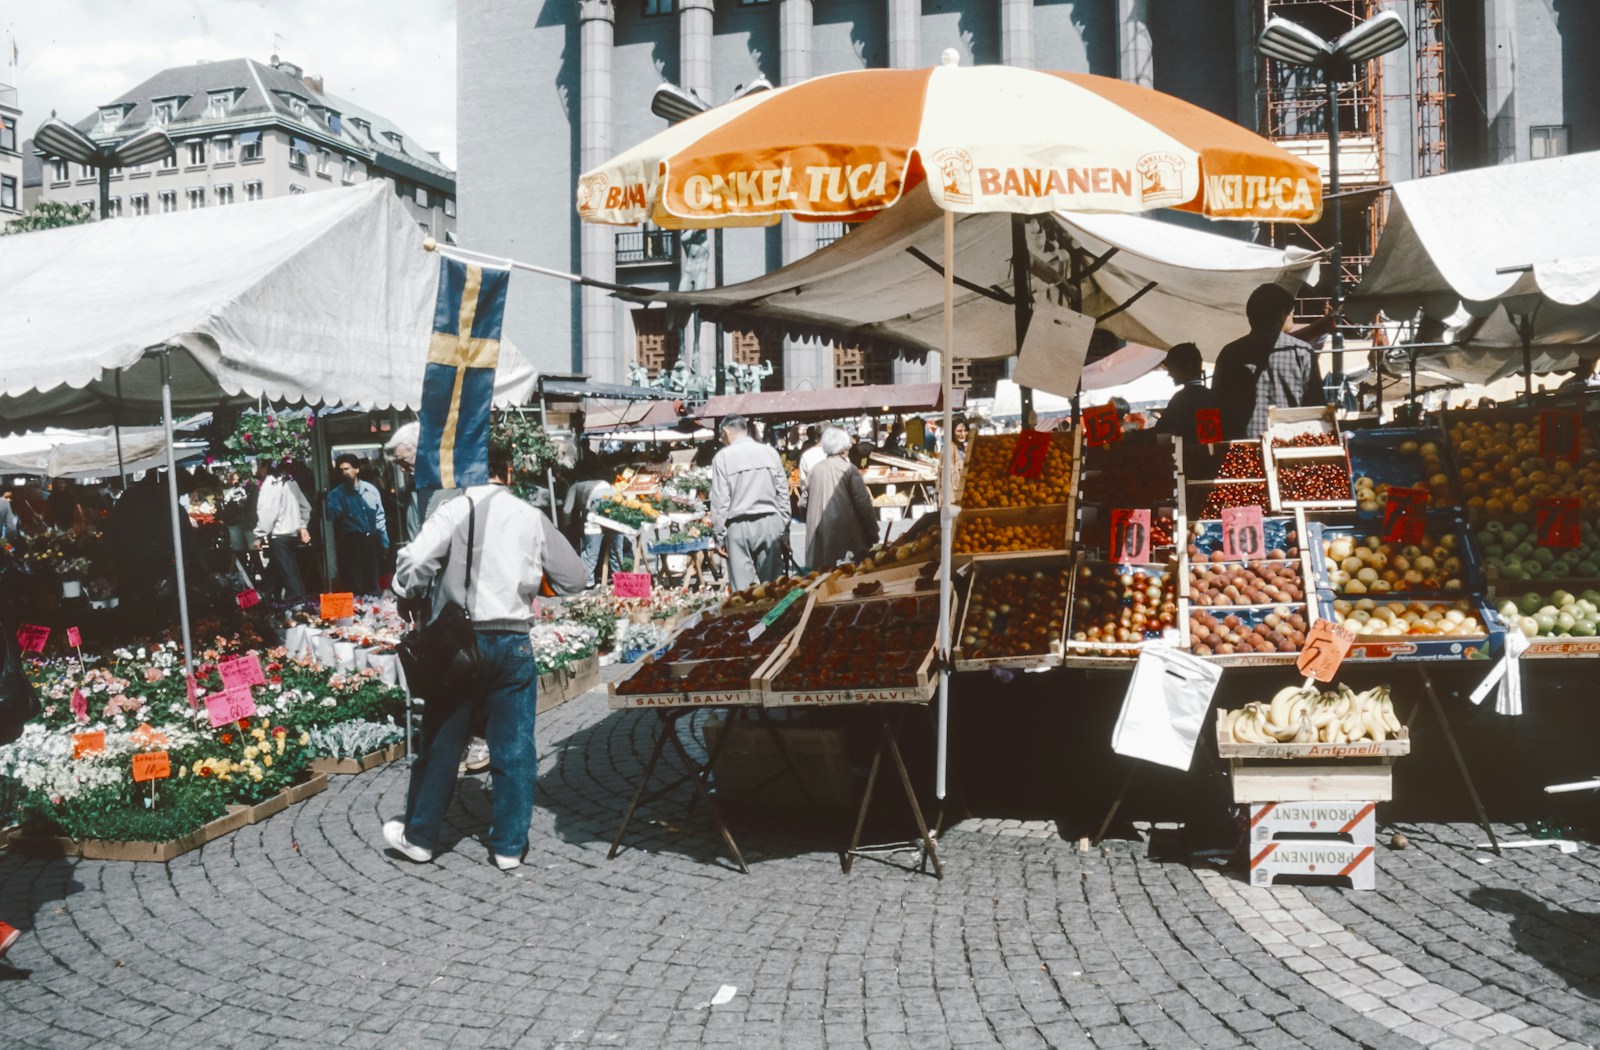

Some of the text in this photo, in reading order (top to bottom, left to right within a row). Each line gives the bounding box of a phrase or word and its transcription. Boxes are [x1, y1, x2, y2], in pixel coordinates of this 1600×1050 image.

[605, 183, 649, 209] BANA
[684, 161, 887, 209] ONKEL TUCA
[977, 167, 1132, 198] BANANEN
[1203, 174, 1314, 210] NKEL TUCA
[1088, 411, 1116, 442] 15
[1009, 444, 1041, 473] 15
[1115, 522, 1145, 558] 10
[1225, 525, 1258, 555] 10
[1300, 637, 1333, 671] 5
[1528, 644, 1564, 653] ELGIE
[636, 694, 740, 706] SALVI SALVI
[792, 691, 905, 703] SALVI SALVI
[1257, 744, 1381, 756] Fabio Antonelli
[1273, 808, 1357, 821] PROMINENT
[1271, 851, 1354, 864] PROMINENT
